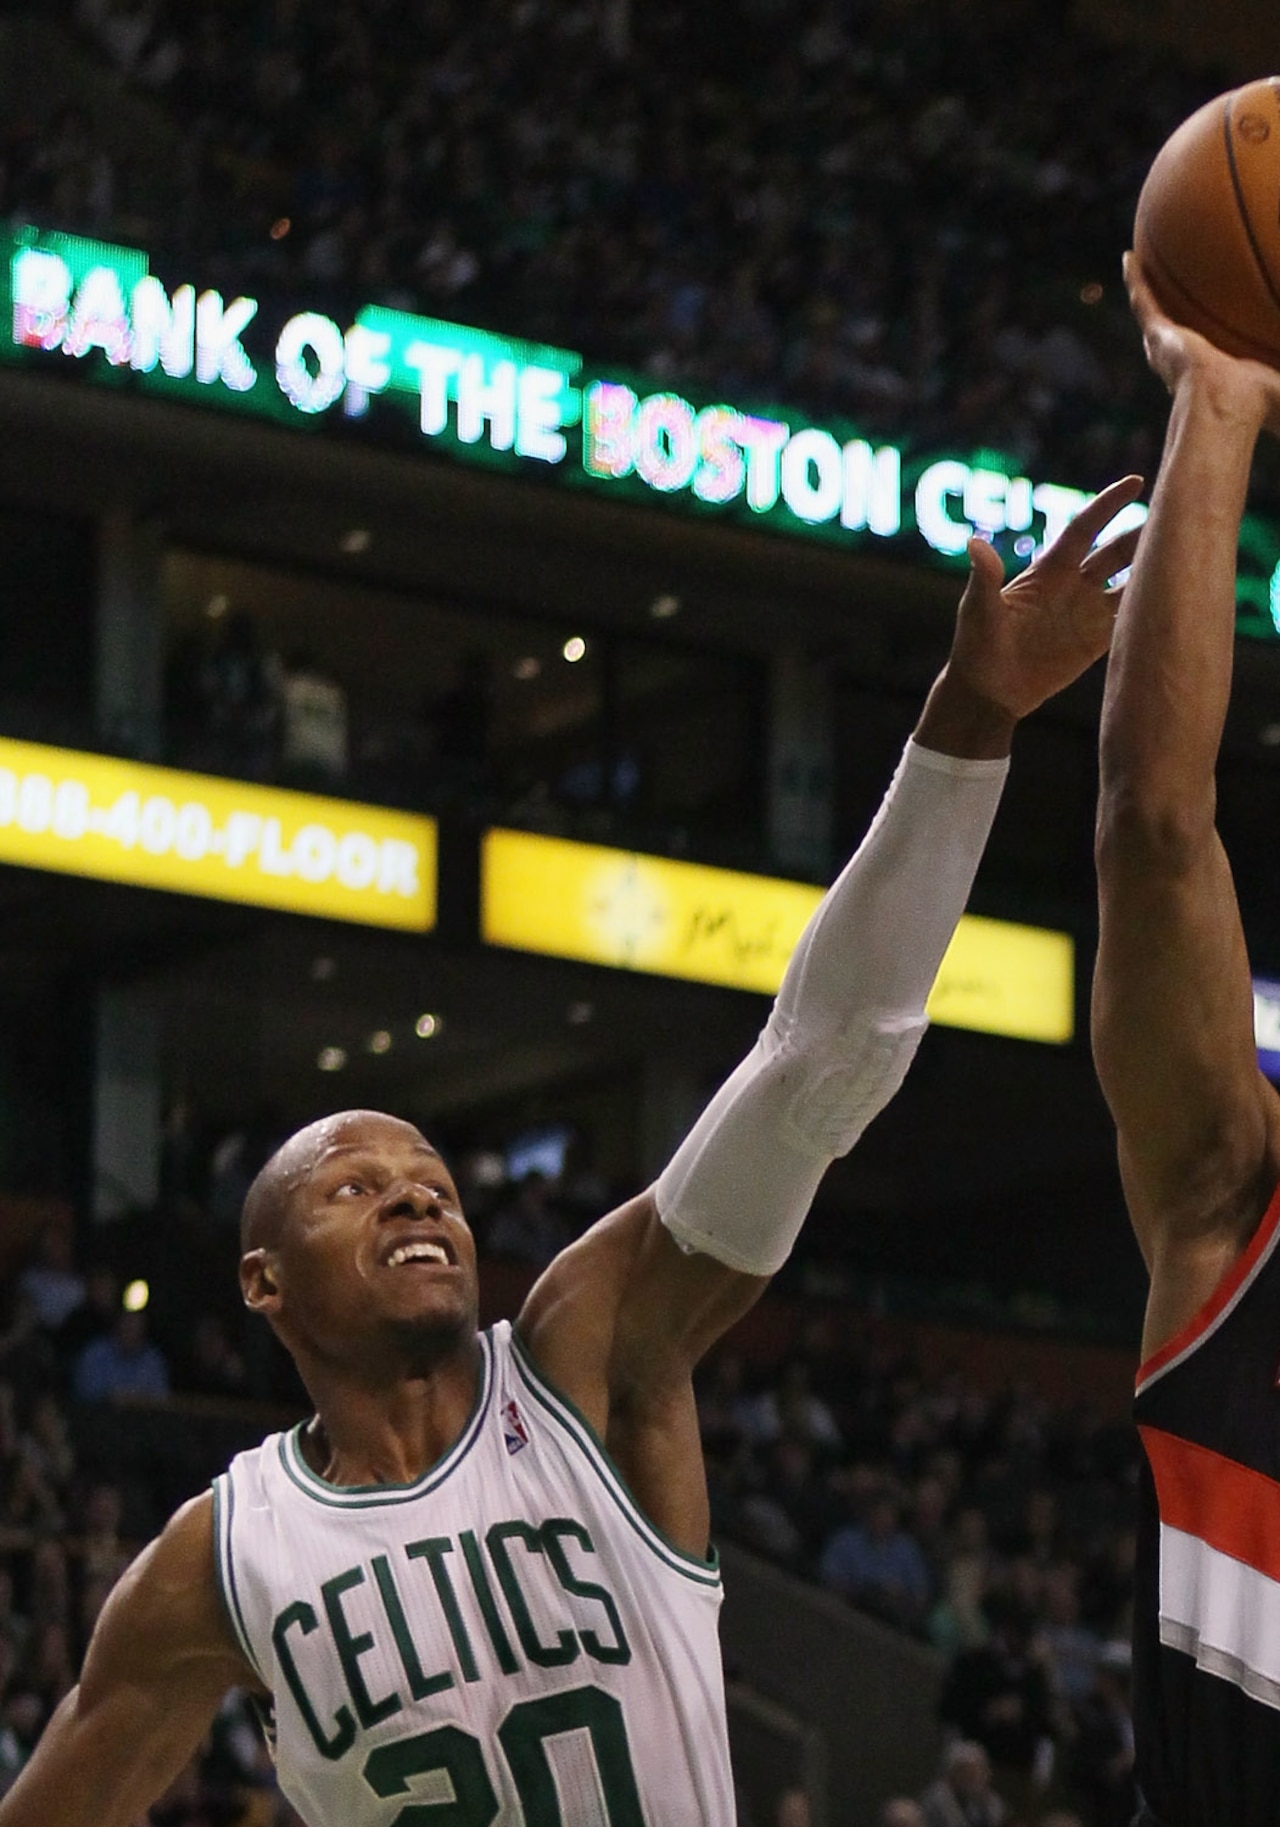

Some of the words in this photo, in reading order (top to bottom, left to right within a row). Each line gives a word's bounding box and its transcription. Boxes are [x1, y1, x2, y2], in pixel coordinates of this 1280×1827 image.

[12, 246, 258, 392] BANK
[275, 311, 392, 416] OF
[406, 341, 568, 463] THE
[583, 378, 902, 537] BOSTON
[272, 1517, 632, 1761] CELTICS
